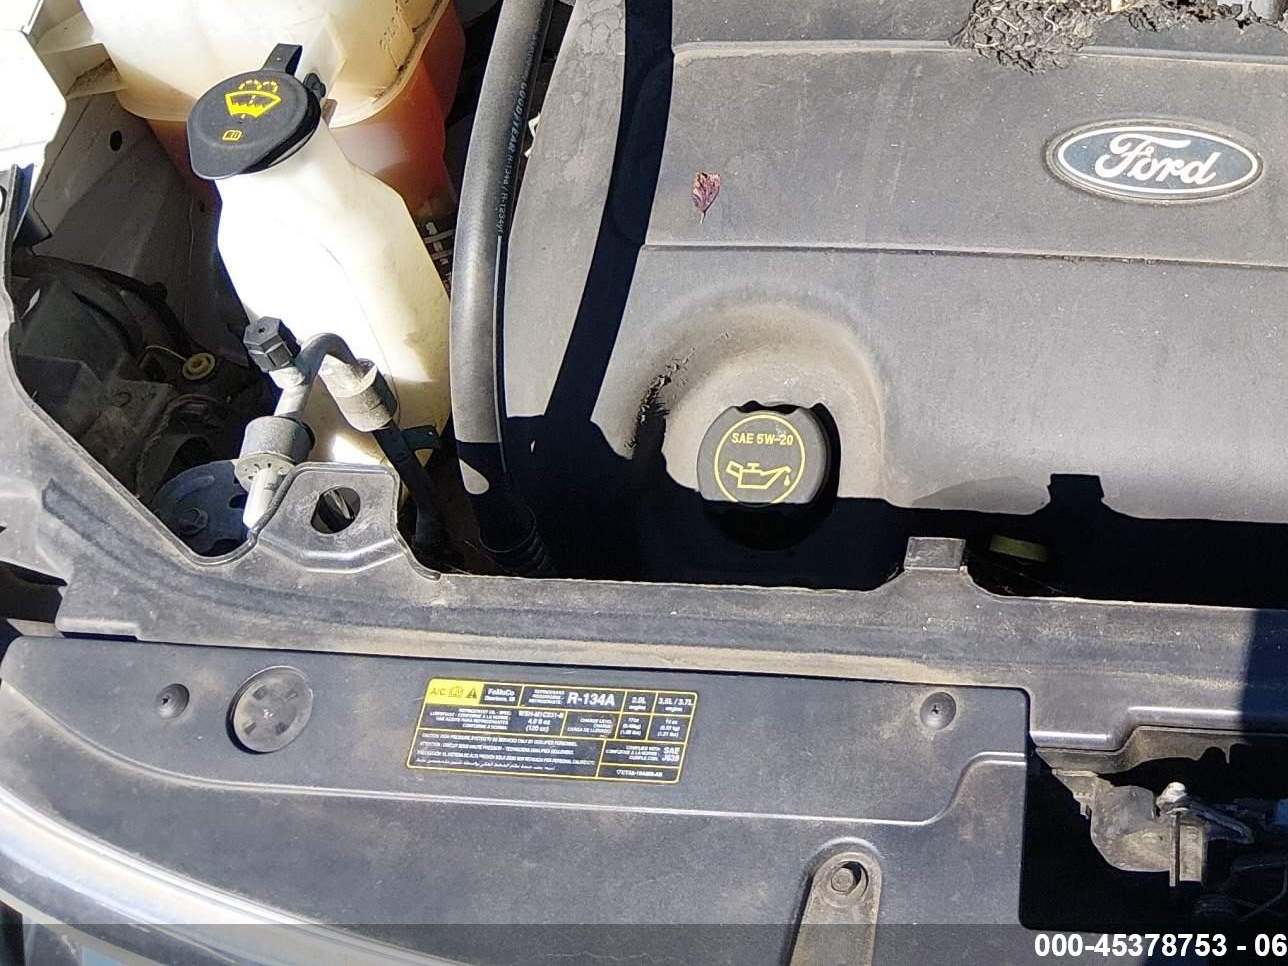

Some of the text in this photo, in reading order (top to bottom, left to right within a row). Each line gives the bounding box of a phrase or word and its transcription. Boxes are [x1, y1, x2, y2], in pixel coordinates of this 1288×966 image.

[1094, 133, 1222, 185] Ford
[731, 432, 794, 446] SAE 5W-20
[430, 687, 447, 696] A/C
[566, 691, 616, 707] R-134A
[663, 746, 681, 755] SAE
